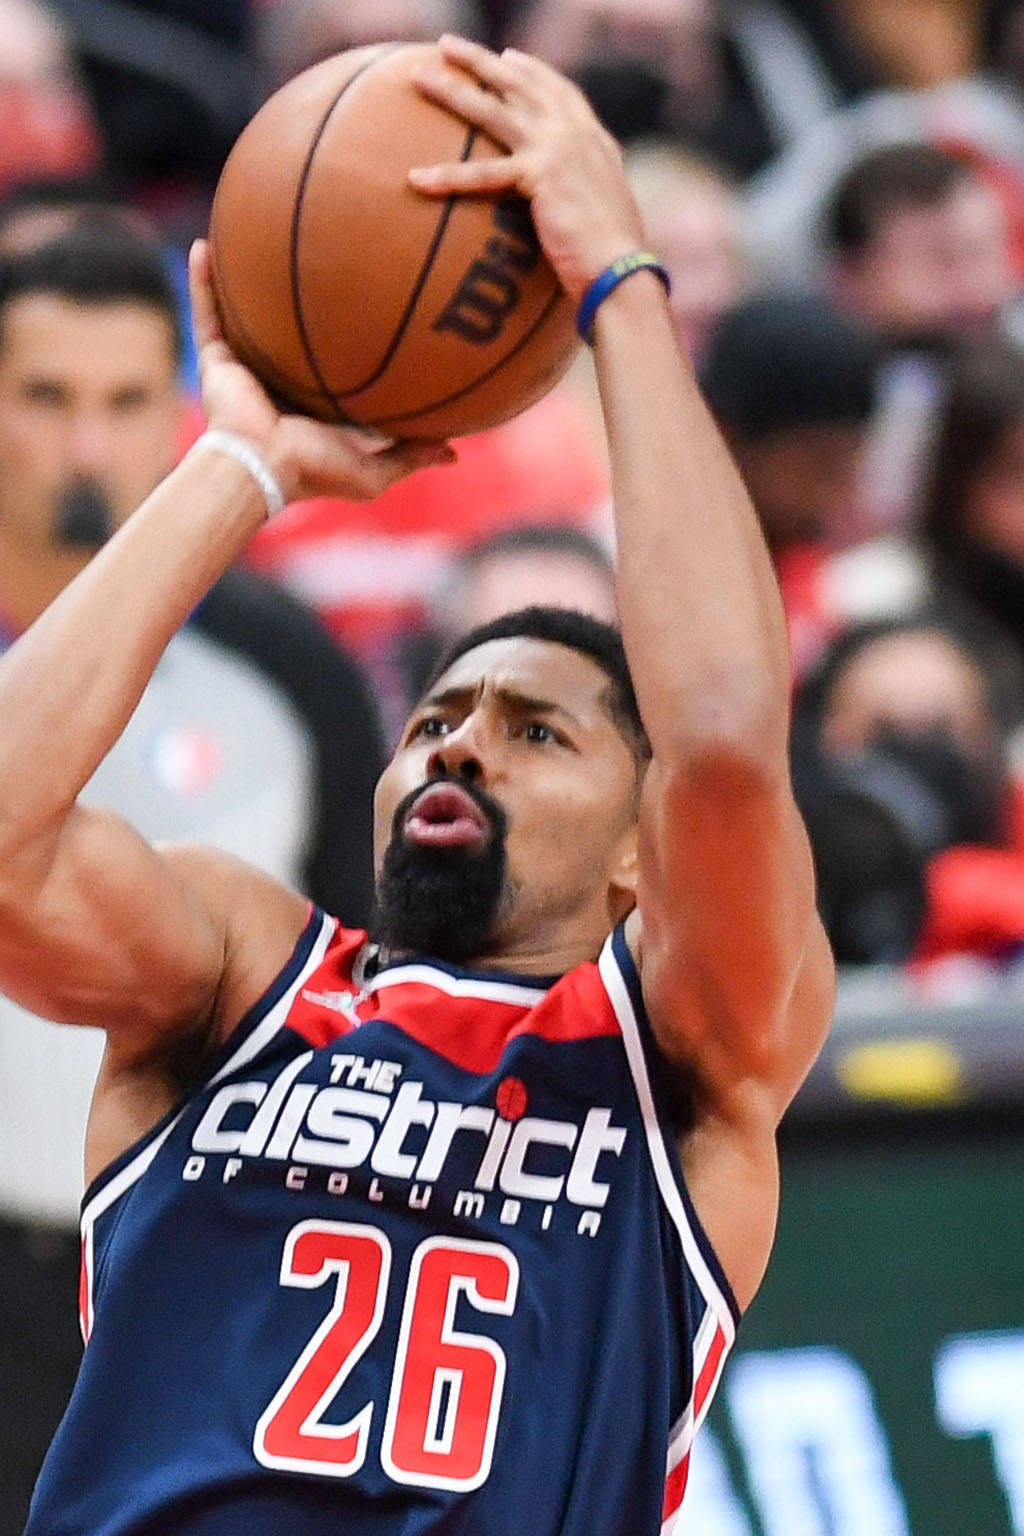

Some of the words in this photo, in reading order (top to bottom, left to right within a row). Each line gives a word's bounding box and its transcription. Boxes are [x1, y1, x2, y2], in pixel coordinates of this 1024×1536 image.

[190, 1050, 629, 1208] district
[329, 1052, 404, 1093] THE
[181, 1155, 243, 1185] OF
[284, 1165, 603, 1239] COLUMBIA
[252, 1218, 521, 1493] 26
